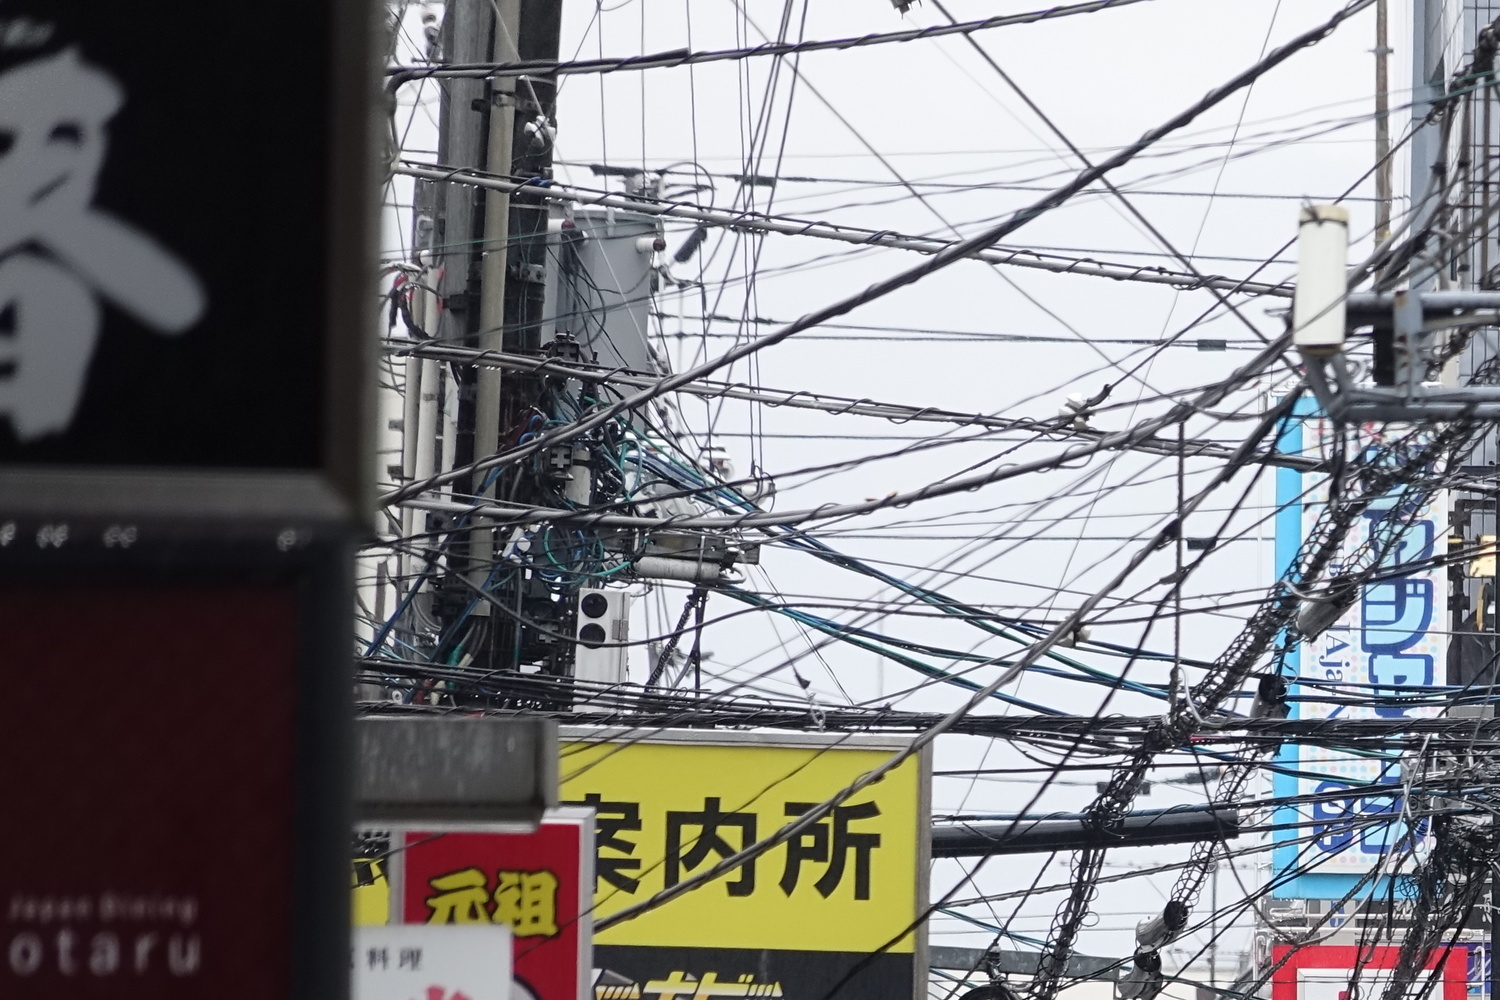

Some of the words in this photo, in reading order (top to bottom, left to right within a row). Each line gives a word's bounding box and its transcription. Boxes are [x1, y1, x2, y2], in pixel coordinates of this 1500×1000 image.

[565, 793, 882, 901] 案内所
[350, 947, 423, 971] 料理
